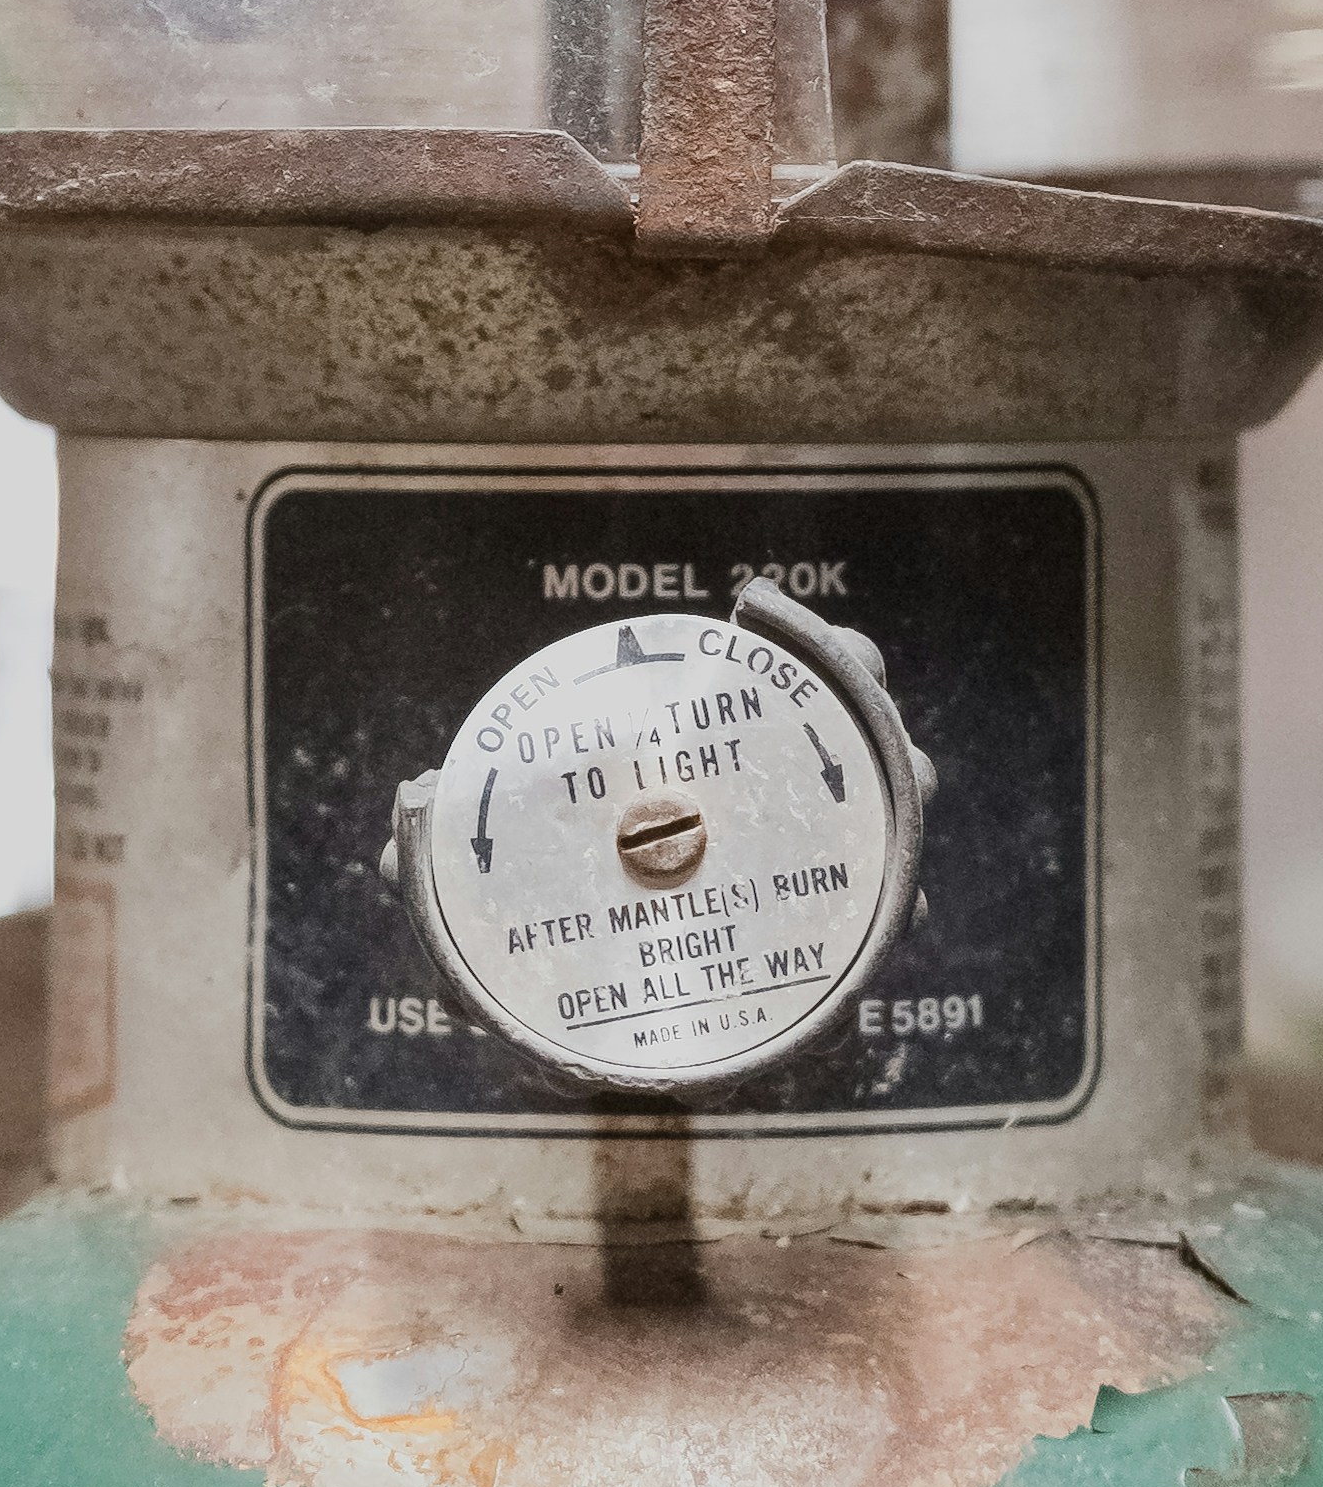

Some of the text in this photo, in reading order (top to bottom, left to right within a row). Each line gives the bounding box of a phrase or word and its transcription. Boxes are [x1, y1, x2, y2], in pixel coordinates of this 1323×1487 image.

[542, 562, 711, 599] MODEL
[698, 628, 820, 709] CLOSE
[475, 665, 561, 754] OPEN
[516, 716, 616, 764] OPEN
[664, 686, 764, 735] TURN
[561, 738, 743, 804] TO LIGHT
[508, 862, 850, 955] AFTER MANTLE(S) BURN
[557, 941, 826, 1021] OPEN ALL THE WAY
[638, 924, 738, 969] BRIGHT
[369, 996, 452, 1035] USE
[633, 1006, 775, 1049] MADE IN U.S.A.
